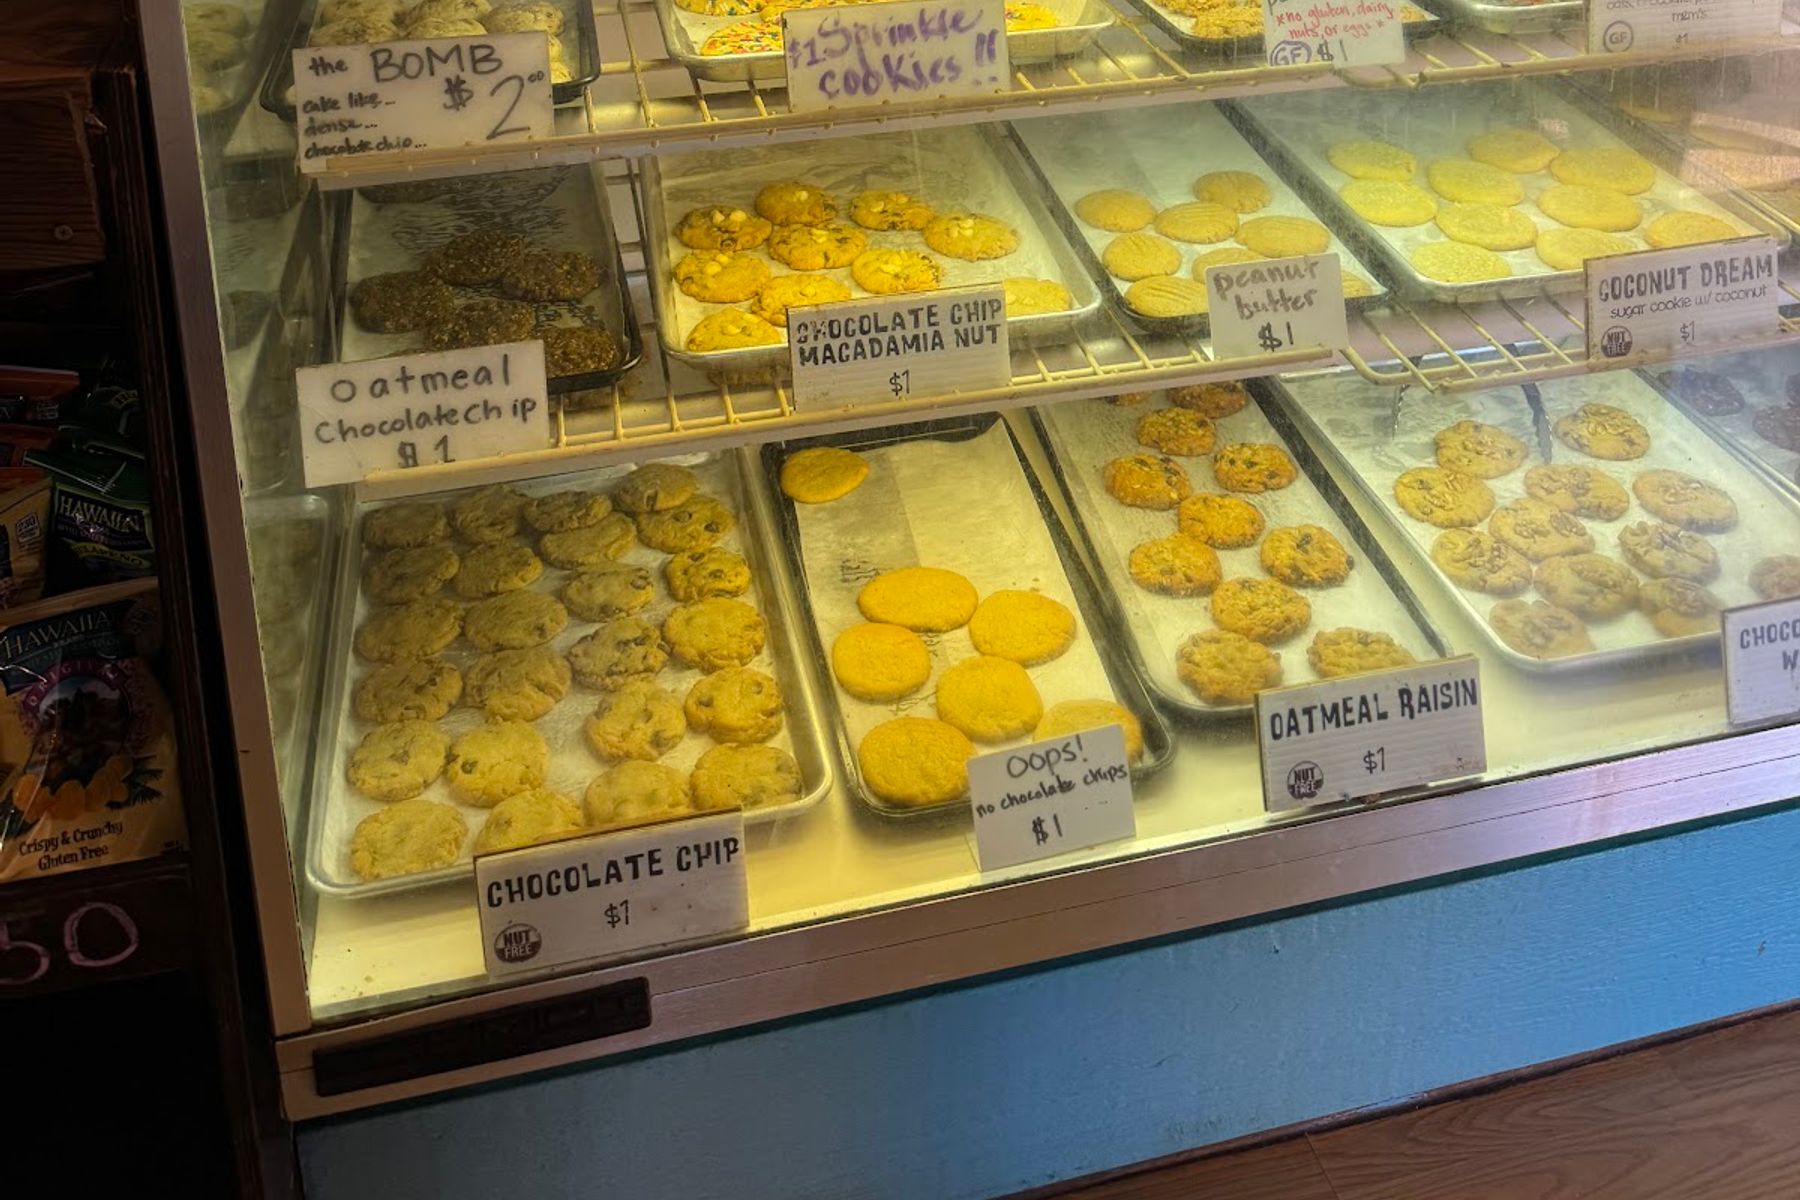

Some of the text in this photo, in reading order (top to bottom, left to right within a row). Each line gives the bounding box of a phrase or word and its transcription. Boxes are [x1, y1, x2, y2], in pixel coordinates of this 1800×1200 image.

[1325, 23, 1337, 36] or
[309, 44, 502, 82] the BOMB
[303, 96, 340, 114] cake
[1600, 254, 1773, 302] COCONUT DREAM
[1235, 288, 1318, 320] butter
[1611, 304, 1645, 319] sugar
[1650, 297, 1692, 312] cookie
[1715, 285, 1768, 302] coconut
[797, 299, 1002, 344] CHOCOLATE CHIP
[1258, 321, 1293, 352] $1
[1607, 331, 1625, 343] NUT
[1680, 321, 1695, 341] $1
[799, 324, 1002, 366] MACADAMIA NUT
[889, 370, 910, 396] $1
[1270, 679, 1478, 741] OATMEAL RAISIN
[1007, 733, 1088, 778] Oops!
[1364, 747, 1385, 774] $1
[1294, 766, 1316, 782] NUT
[976, 764, 1128, 818] no chocolate chips
[19, 835, 59, 856] Crispy
[73, 821, 123, 841] Crunchy
[38, 845, 109, 870] Gluten Free
[487, 837, 739, 908] CHOCOLATE CHIP
[605, 900, 630, 929] $1
[503, 928, 531, 946] NUT
[504, 943, 533, 958] FREE
